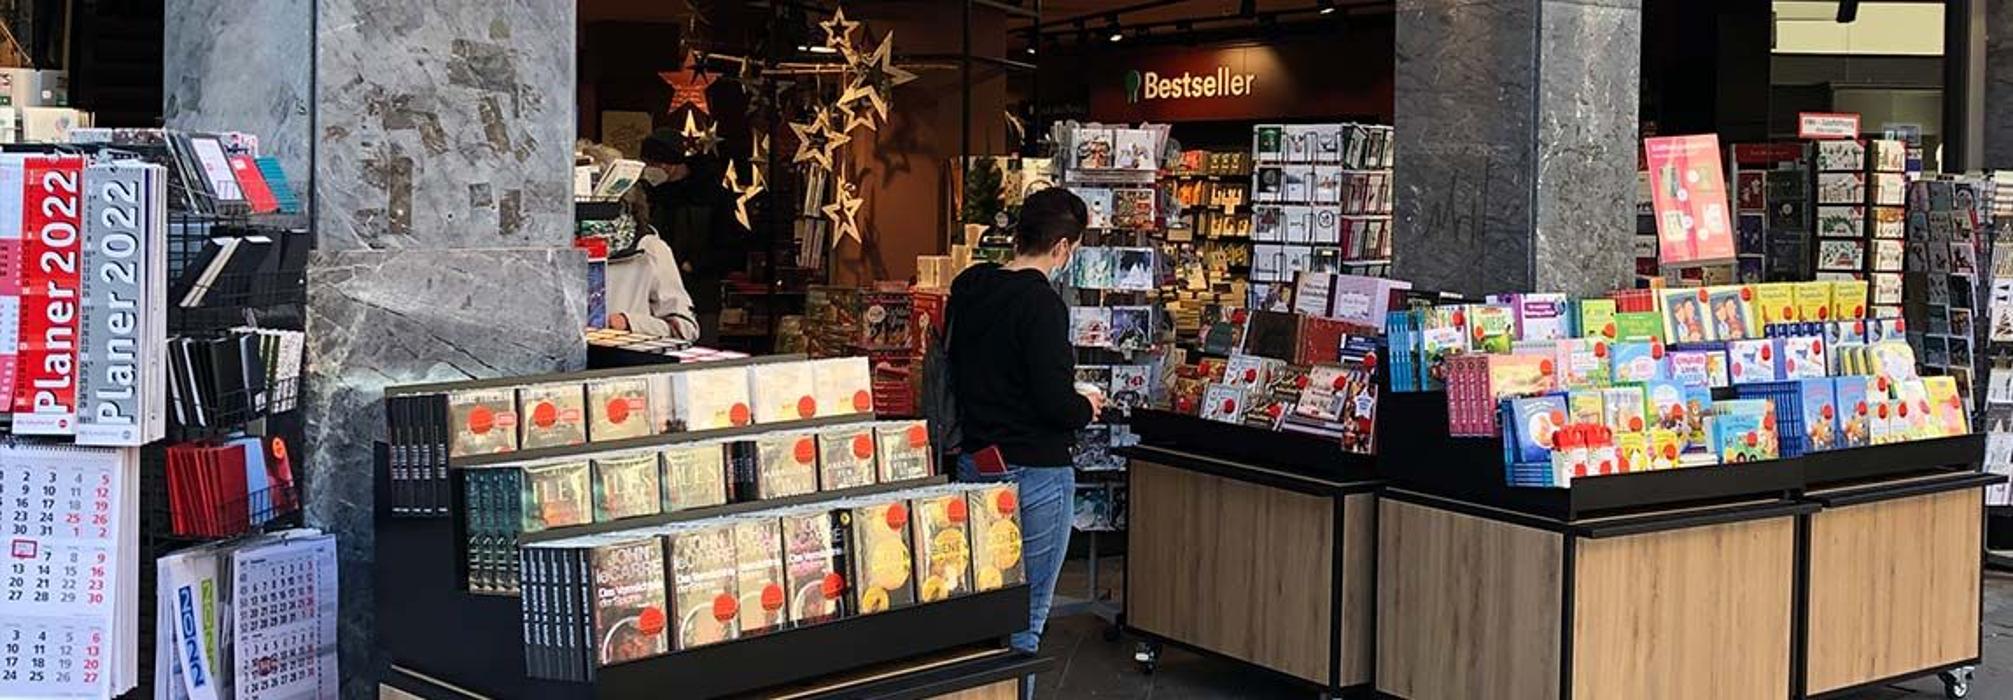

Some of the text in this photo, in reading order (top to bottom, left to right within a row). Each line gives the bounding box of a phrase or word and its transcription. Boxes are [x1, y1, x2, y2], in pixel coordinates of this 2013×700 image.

[1144, 66, 1255, 99] Bestseller
[40, 169, 79, 274] 2022
[100, 180, 139, 284] 2022
[34, 281, 76, 413] Planer
[96, 291, 137, 424] Planer
[23, 471, 110, 485] 2 3 4 5
[22, 484, 109, 498] 9 10 11 12
[16, 498, 108, 511] 16 17 18 19
[14, 511, 108, 525] 23 24 25 26
[13, 524, 107, 538] 30 31 1 2
[44, 552, 106, 564] 7 8 9
[12, 564, 105, 577] 13 14 15 16
[9, 577, 104, 590] 20 21 22 23
[8, 590, 103, 603] 27 28 29 30
[13, 630, 101, 642] 3 4 5 6
[178, 586, 205, 688] 2022
[6, 643, 99, 656] 10 11 12 13
[5, 656, 99, 669] 17 18 19 20
[3, 670, 98, 683] 24 25 26 27
